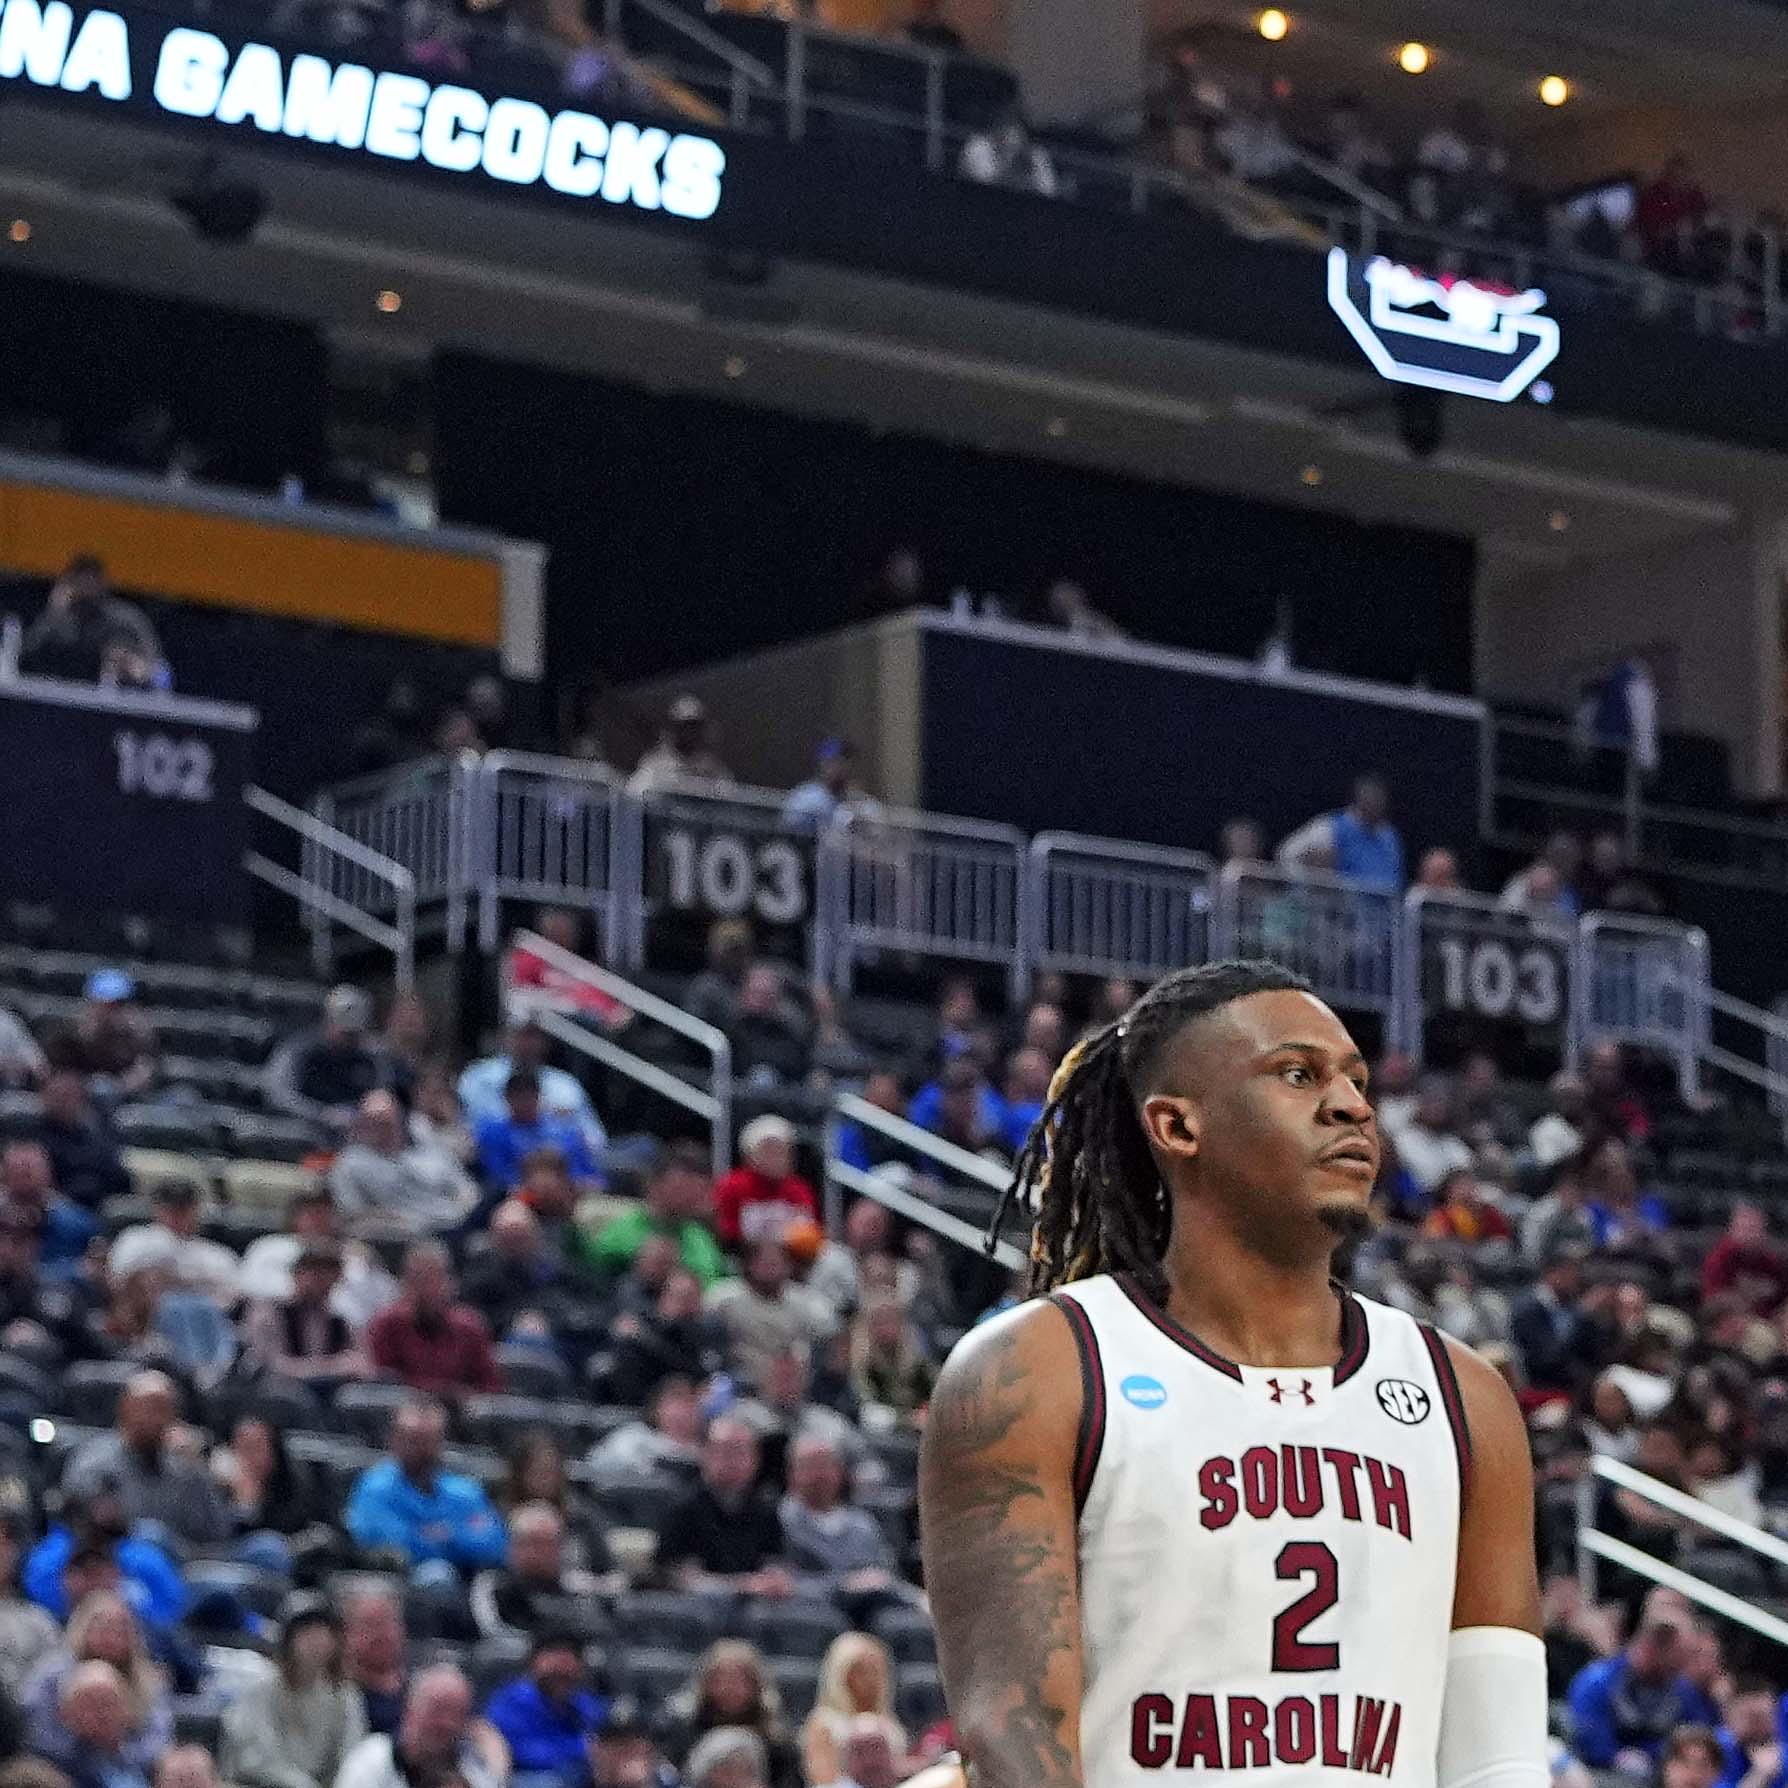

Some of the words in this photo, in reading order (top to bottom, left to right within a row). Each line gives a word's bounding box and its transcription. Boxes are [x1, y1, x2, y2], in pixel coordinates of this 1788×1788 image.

[154, 27, 726, 219] GAMECOCKS
[663, 829, 806, 924] 103
[1436, 936, 1563, 1022] 103
[1199, 1443, 1412, 1543] SOUTH
[1270, 1541, 1341, 1674] 2
[1130, 1693, 1402, 1779] CAROLINA
